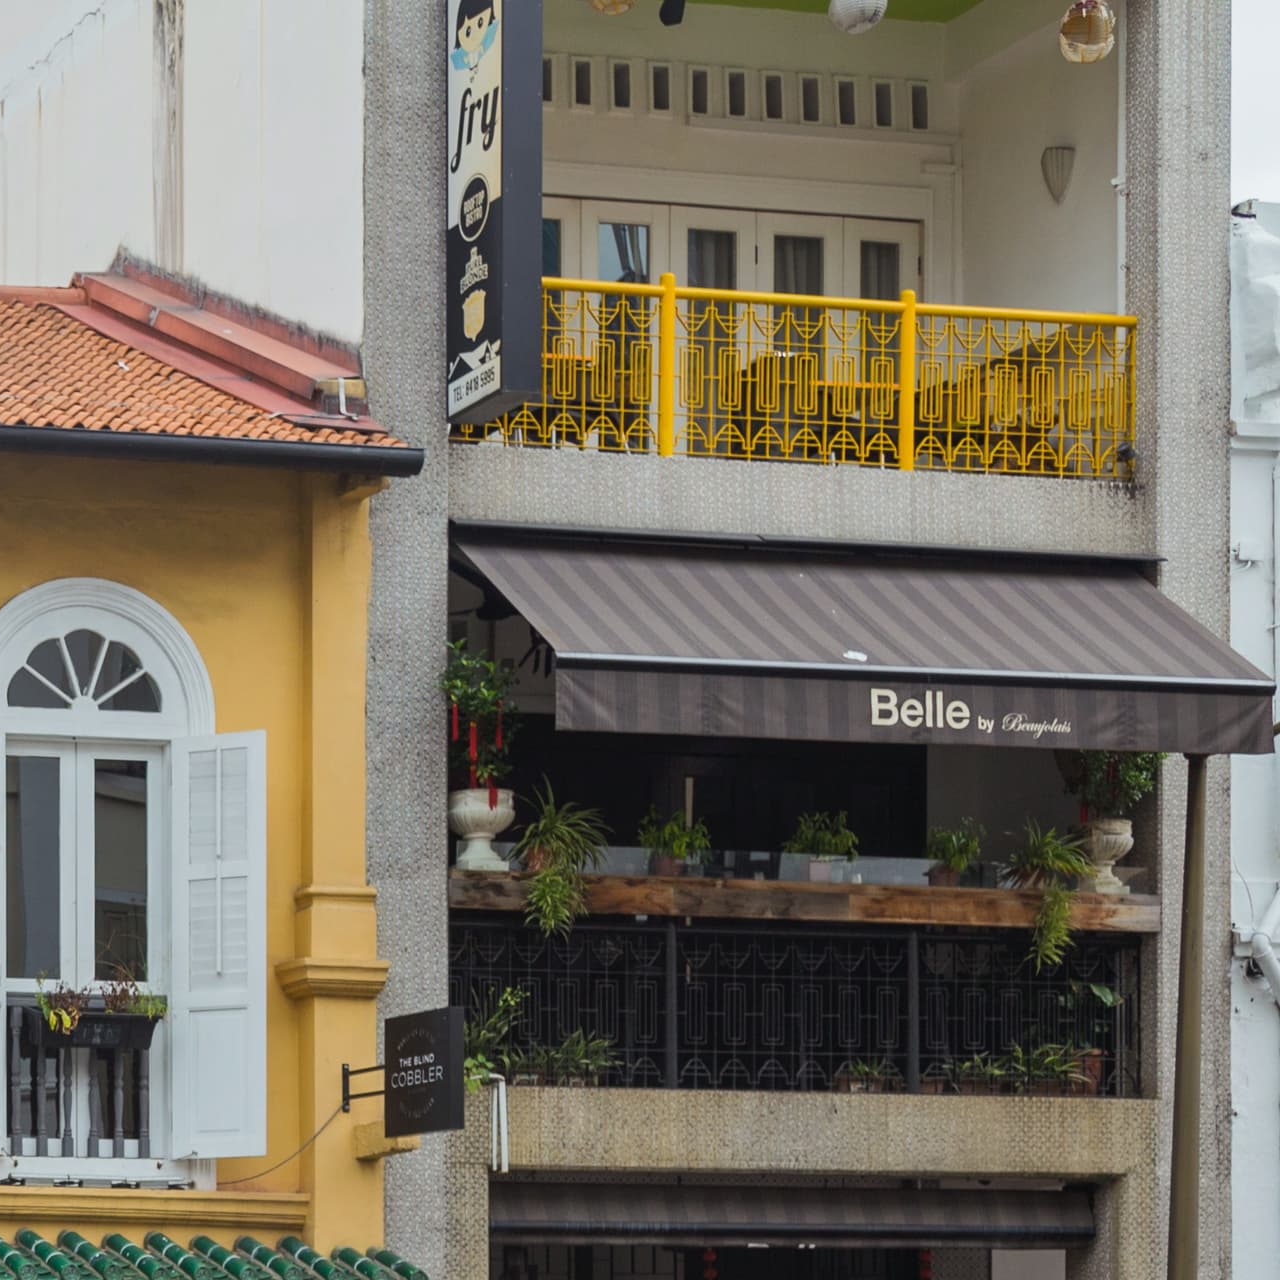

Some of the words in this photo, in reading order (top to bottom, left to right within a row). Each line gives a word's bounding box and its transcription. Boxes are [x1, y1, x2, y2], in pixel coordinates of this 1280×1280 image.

[450, 86, 500, 174] fry
[870, 687, 971, 730] Belle
[977, 715, 995, 734] by
[1001, 712, 1072, 740] Beaujolais
[391, 1065, 444, 1089] COBBLER
[400, 1056, 413, 1068] THE
[413, 1052, 435, 1066] BLIND
